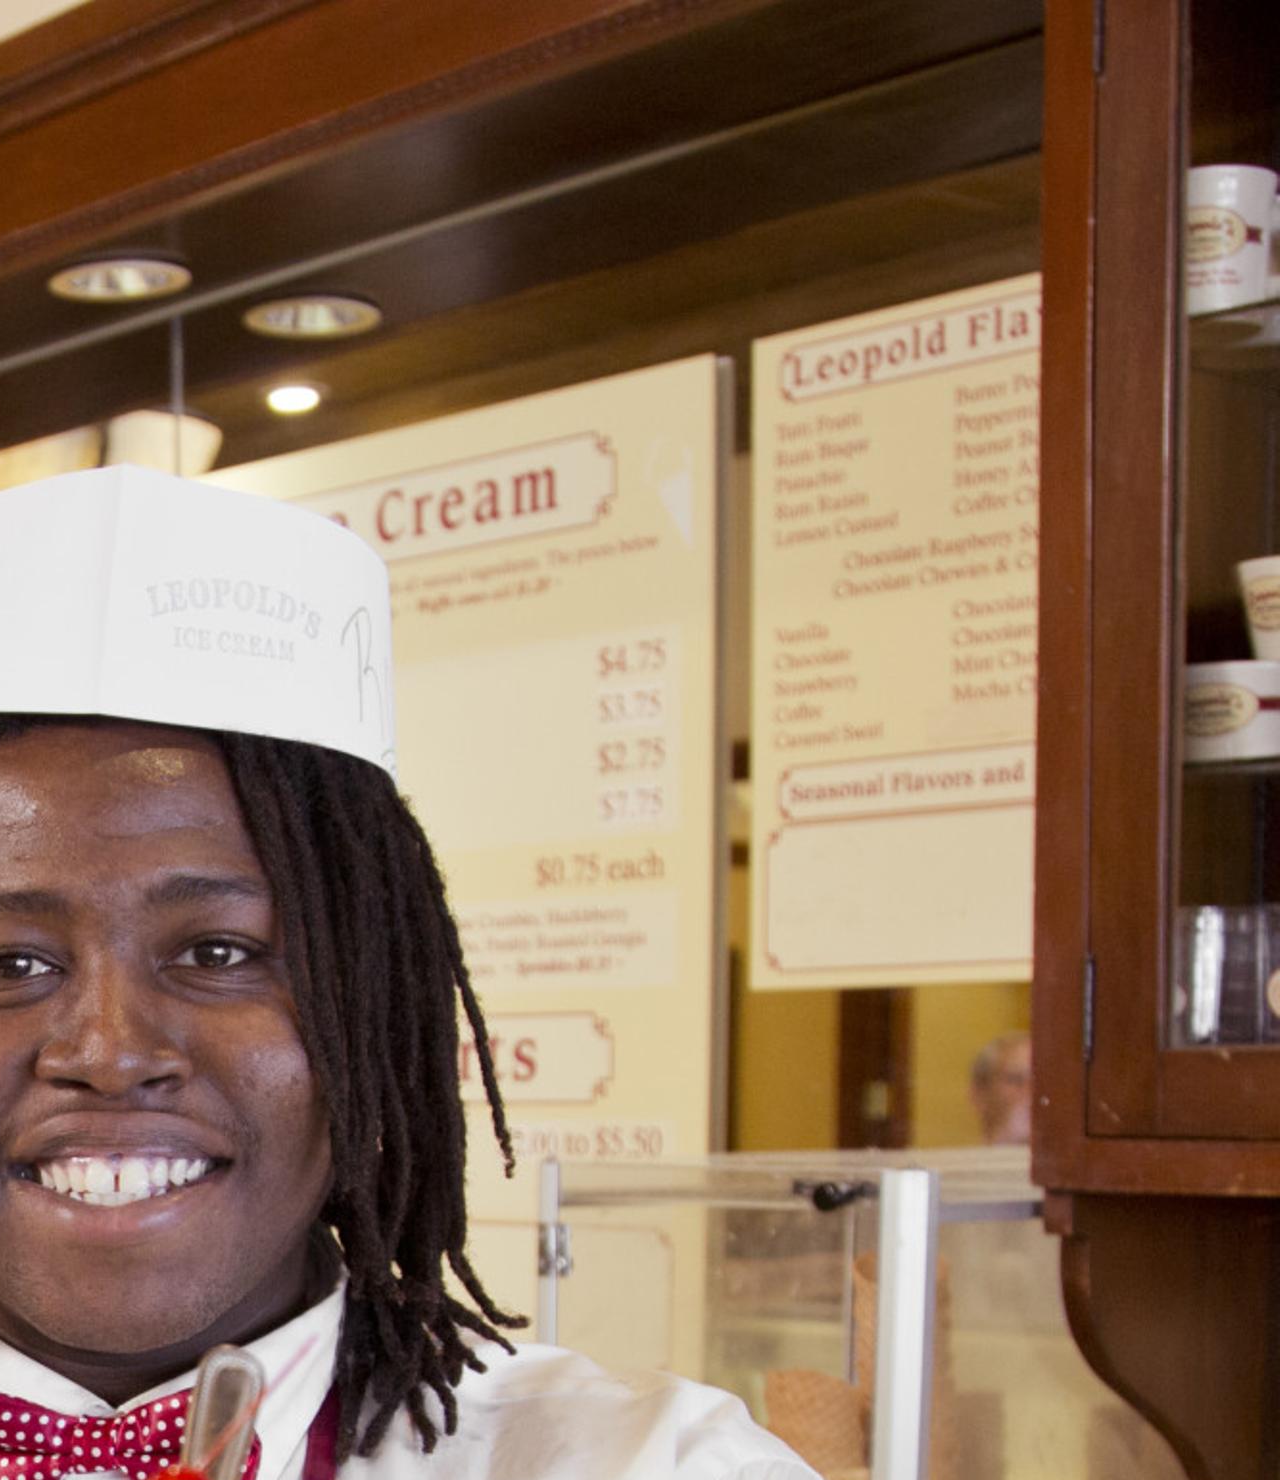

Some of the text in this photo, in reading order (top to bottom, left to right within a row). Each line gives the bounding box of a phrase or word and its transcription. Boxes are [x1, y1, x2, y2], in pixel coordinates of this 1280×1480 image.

[791, 303, 1041, 385] Leopold Fla
[375, 466, 558, 543] Cream
[146, 577, 321, 640] LEOPOLD'S
[172, 626, 294, 662] ICE CREAM
[791, 761, 1025, 802] Seasonal Flavors and
[607, 848, 665, 881] each
